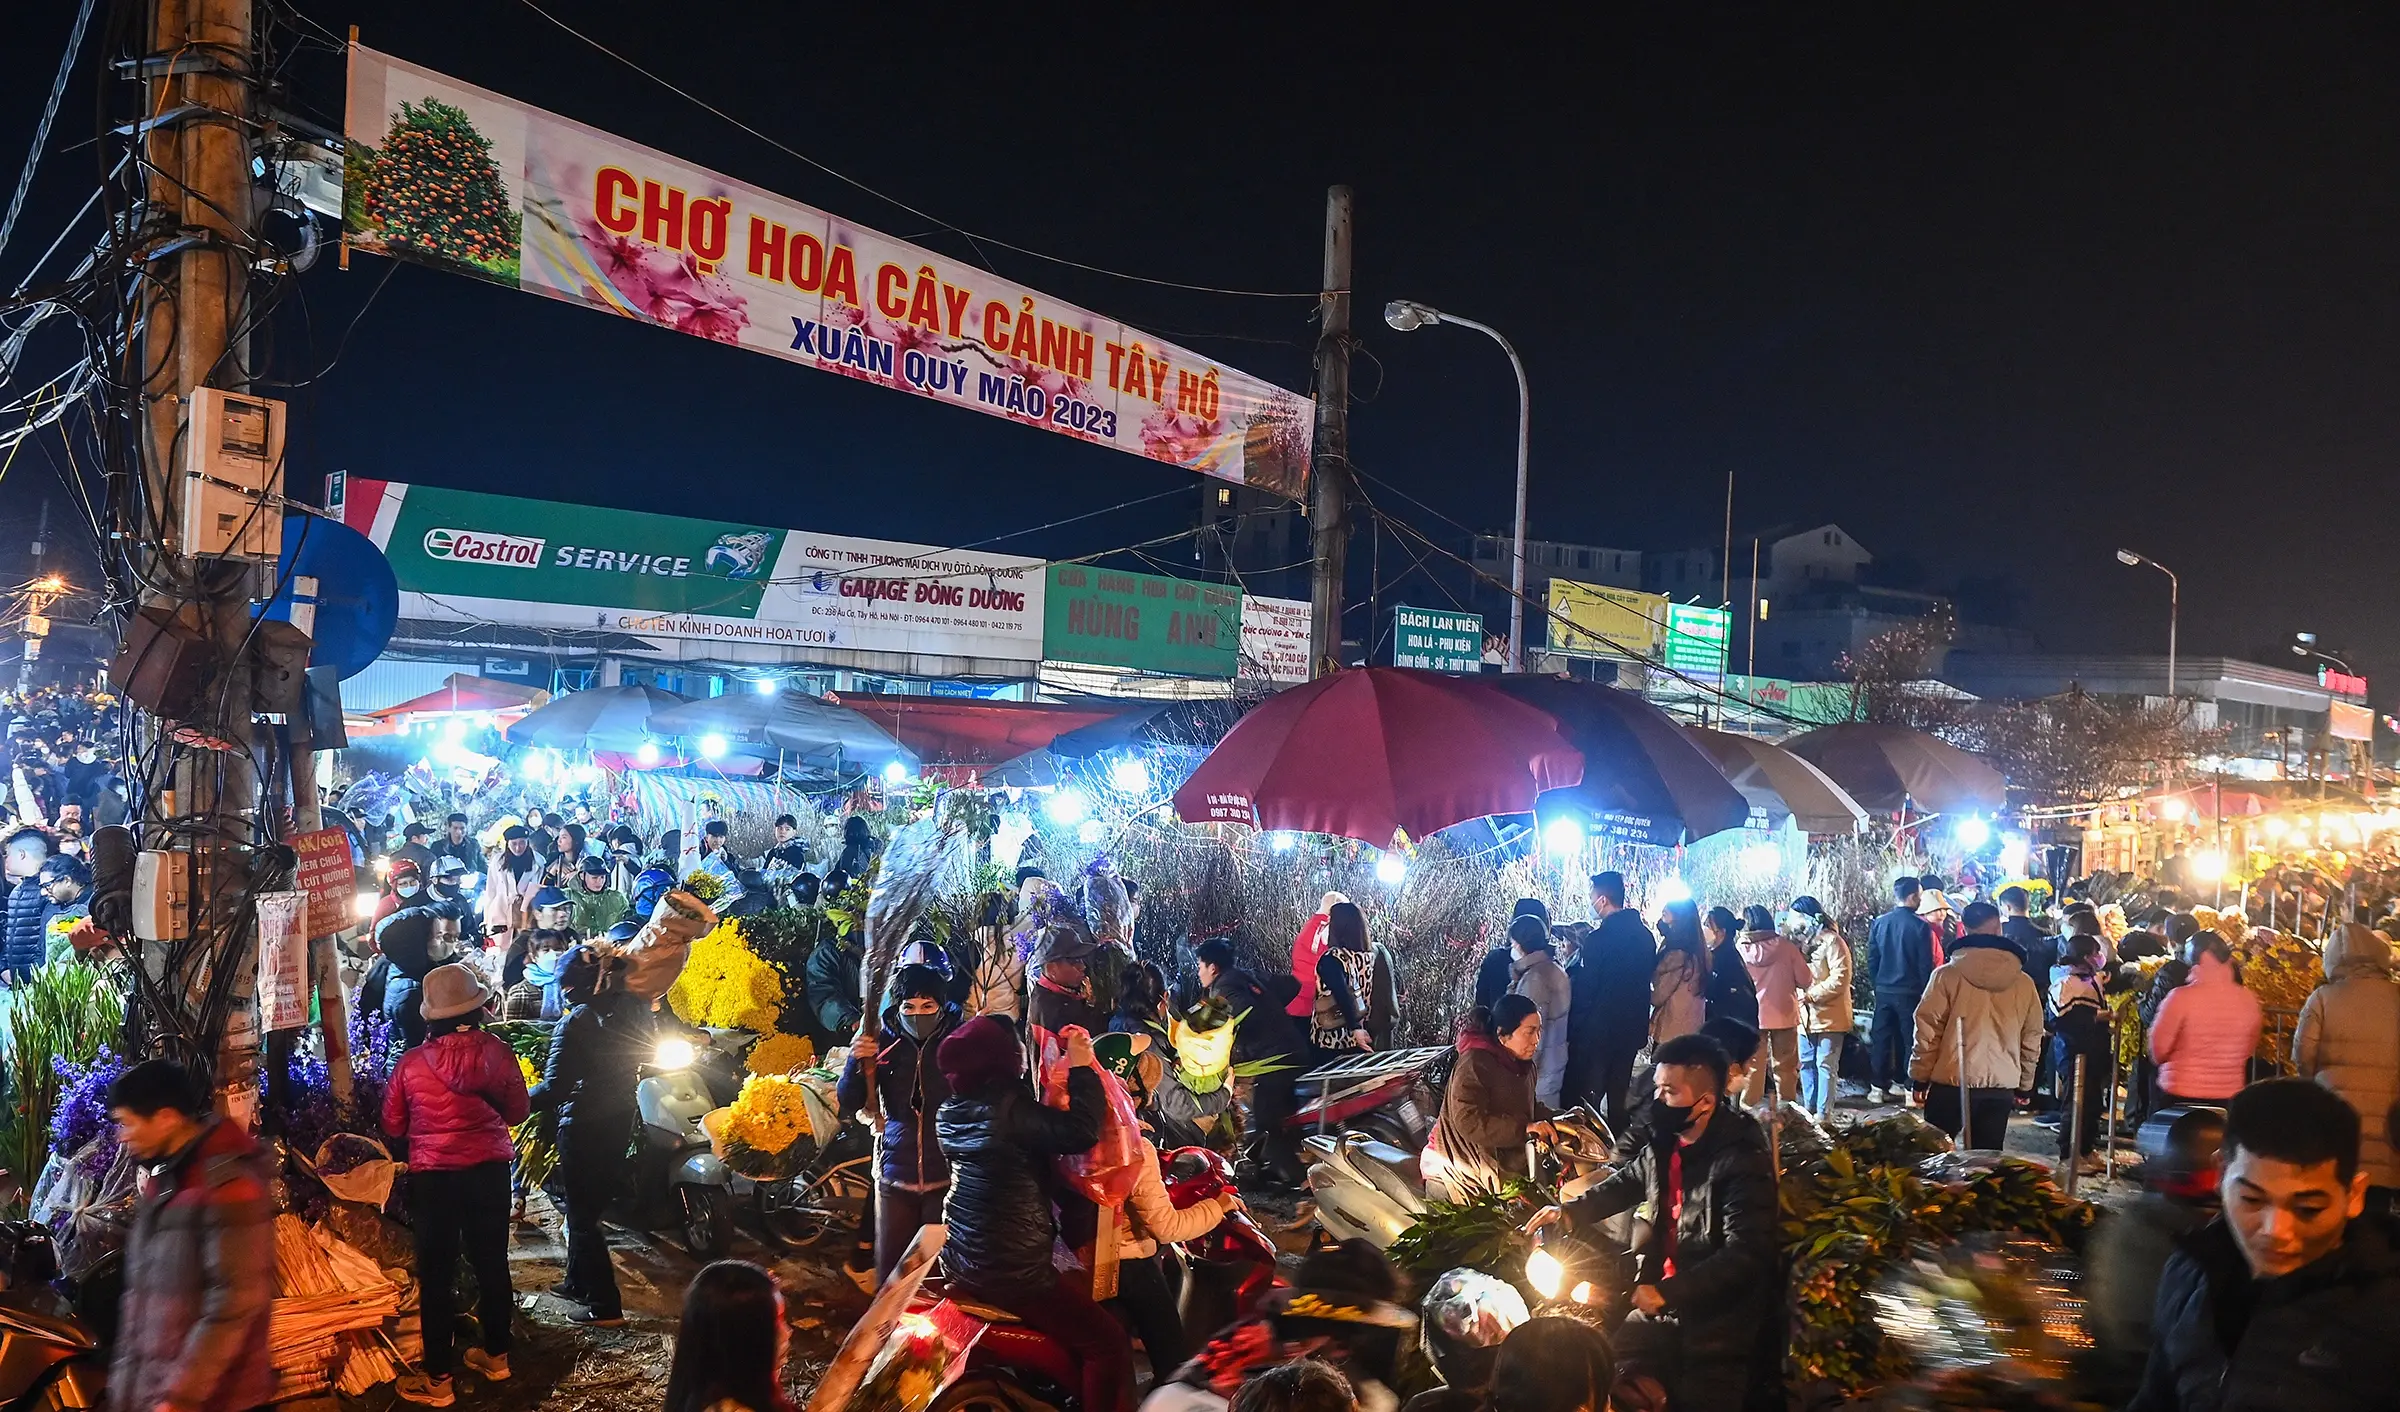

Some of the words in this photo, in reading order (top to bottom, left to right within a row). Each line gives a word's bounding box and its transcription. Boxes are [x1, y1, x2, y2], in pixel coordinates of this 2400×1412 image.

[595, 165, 732, 274] CHỢ
[747, 214, 858, 310] HOA
[876, 262, 972, 340] CÂY
[983, 295, 1093, 380] CẢNH
[1105, 340, 1169, 405] TÂY
[1177, 365, 1220, 423] HỒ
[790, 316, 893, 378] XUÂN
[905, 349, 968, 398] QUÝ
[978, 372, 1045, 422] MÃO
[1052, 394, 1118, 438] 2023
[452, 535, 540, 566] Castrol
[556, 546, 691, 578] SERVICE
[805, 546, 830, 560] CÔNG
[832, 550, 844, 561] TY
[846, 552, 868, 564] TNHH
[905, 558, 920, 571] MẠI
[922, 560, 940, 572] DỊCH
[942, 562, 953, 575] VỤ
[840, 578, 909, 602] GARAGE
[915, 580, 964, 607] ĐÔNG
[969, 587, 1025, 612] DƯƠNG
[1067, 593, 1140, 642] HÙNG
[1167, 610, 1218, 647] ANH
[1400, 611, 1429, 628] BÁCH
[1432, 616, 1453, 630] LAN
[1455, 618, 1480, 633] VIÊN
[714, 623, 762, 639] DOANH
[766, 628, 792, 641] HOA
[796, 628, 826, 643] TƯƠI
[1408, 634, 1422, 648] HOA
[1424, 634, 1433, 649] LÁ
[1439, 638, 1453, 654] PHỤ
[1454, 638, 1471, 654] KIỆN
[1397, 652, 1414, 668] BÌNH
[1466, 660, 1479, 672] TINH
[1630, 829, 1648, 839] 234
[299, 859, 318, 873] NEM
